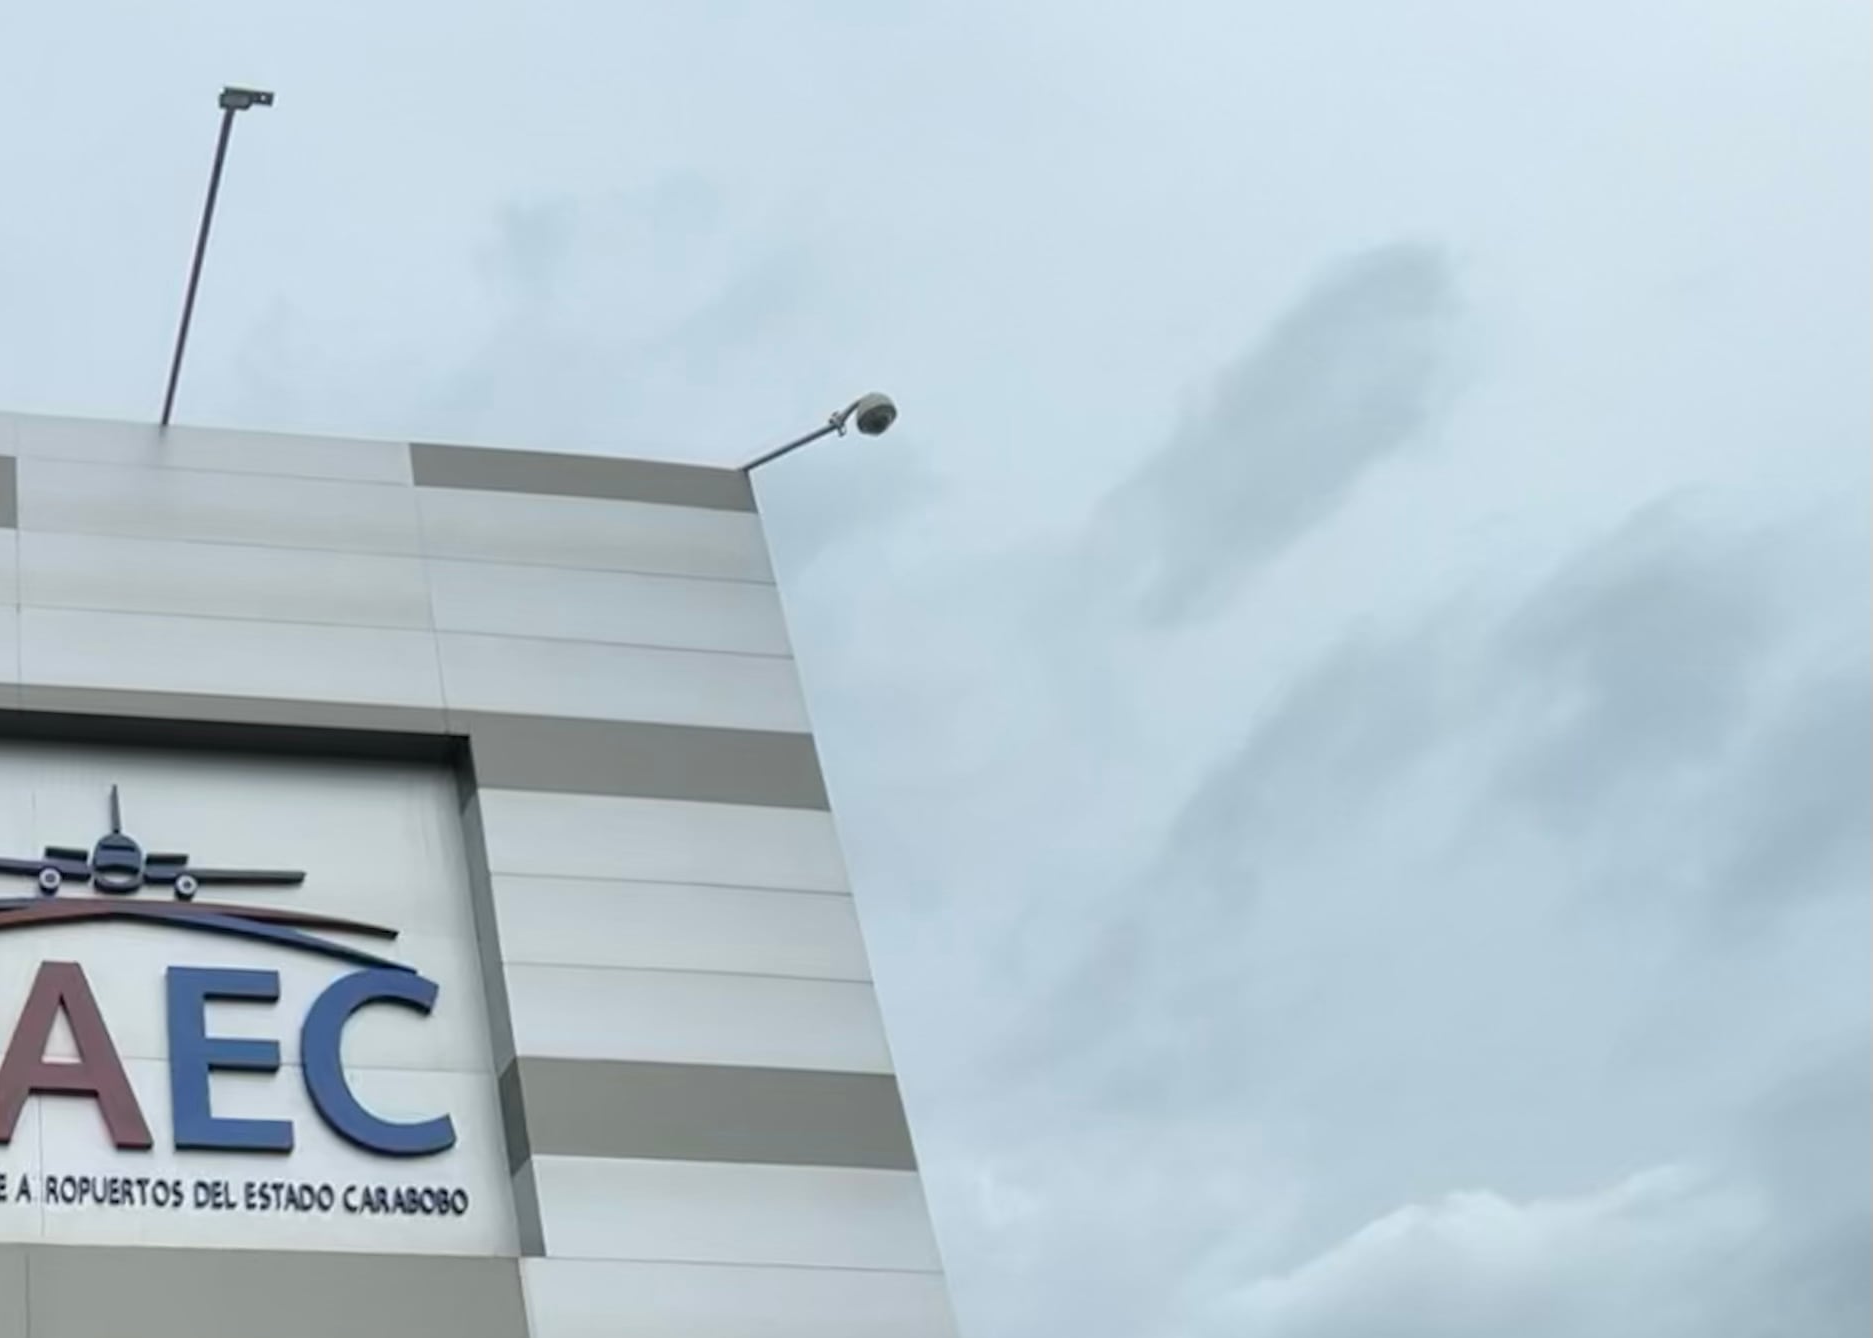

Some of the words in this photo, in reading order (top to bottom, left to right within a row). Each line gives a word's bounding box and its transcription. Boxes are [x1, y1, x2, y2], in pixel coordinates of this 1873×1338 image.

[193, 1181, 238, 1210] DEL
[244, 1183, 335, 1213] ESTADO
[342, 1186, 469, 1217] CARABOBO
